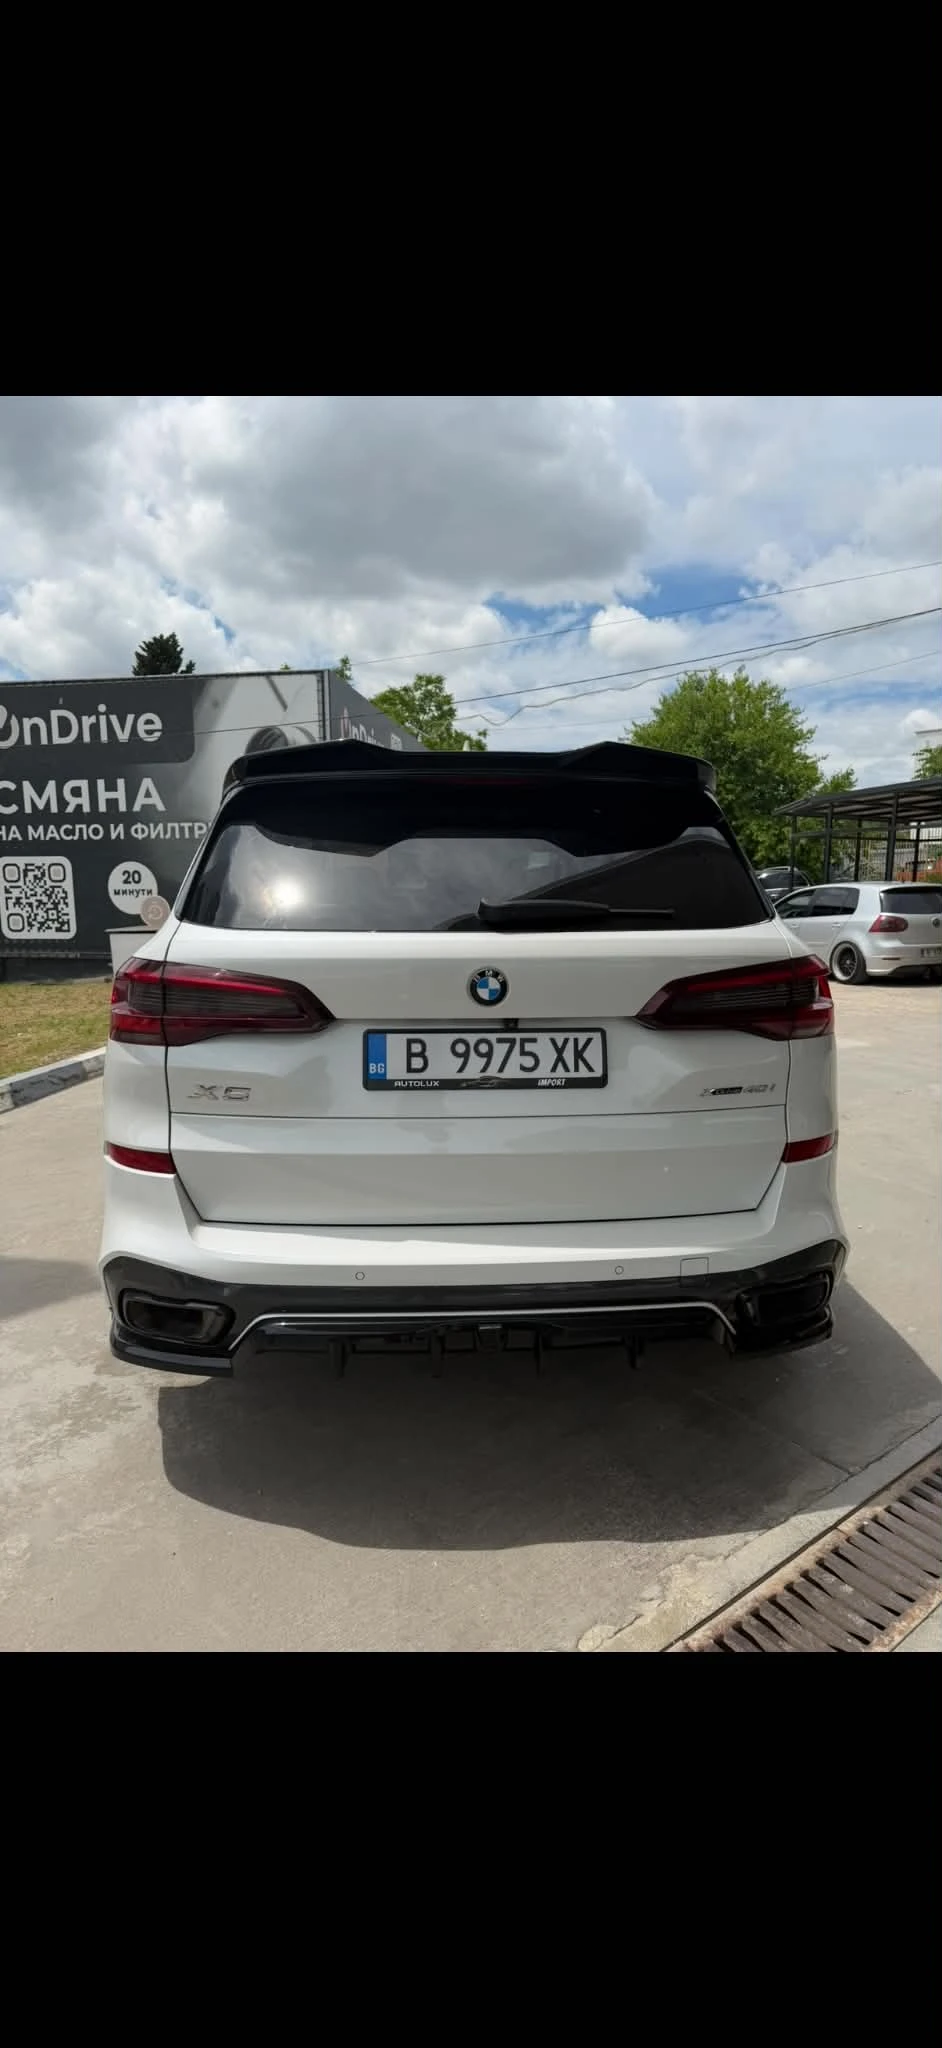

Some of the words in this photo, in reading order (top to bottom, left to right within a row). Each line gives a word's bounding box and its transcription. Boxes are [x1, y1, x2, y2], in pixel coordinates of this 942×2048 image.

[0, 777, 167, 815] СМЯНА
[27, 823, 105, 842] МАСЛО
[110, 823, 125, 840] И
[131, 821, 212, 840] ФИЛТР
[121, 870, 142, 885] 20
[369, 1063, 385, 1074] BG
[405, 1038, 429, 1074] B
[450, 1037, 540, 1073] 9975
[549, 1037, 595, 1073] XK
[394, 1080, 440, 1088] AUTOLUX
